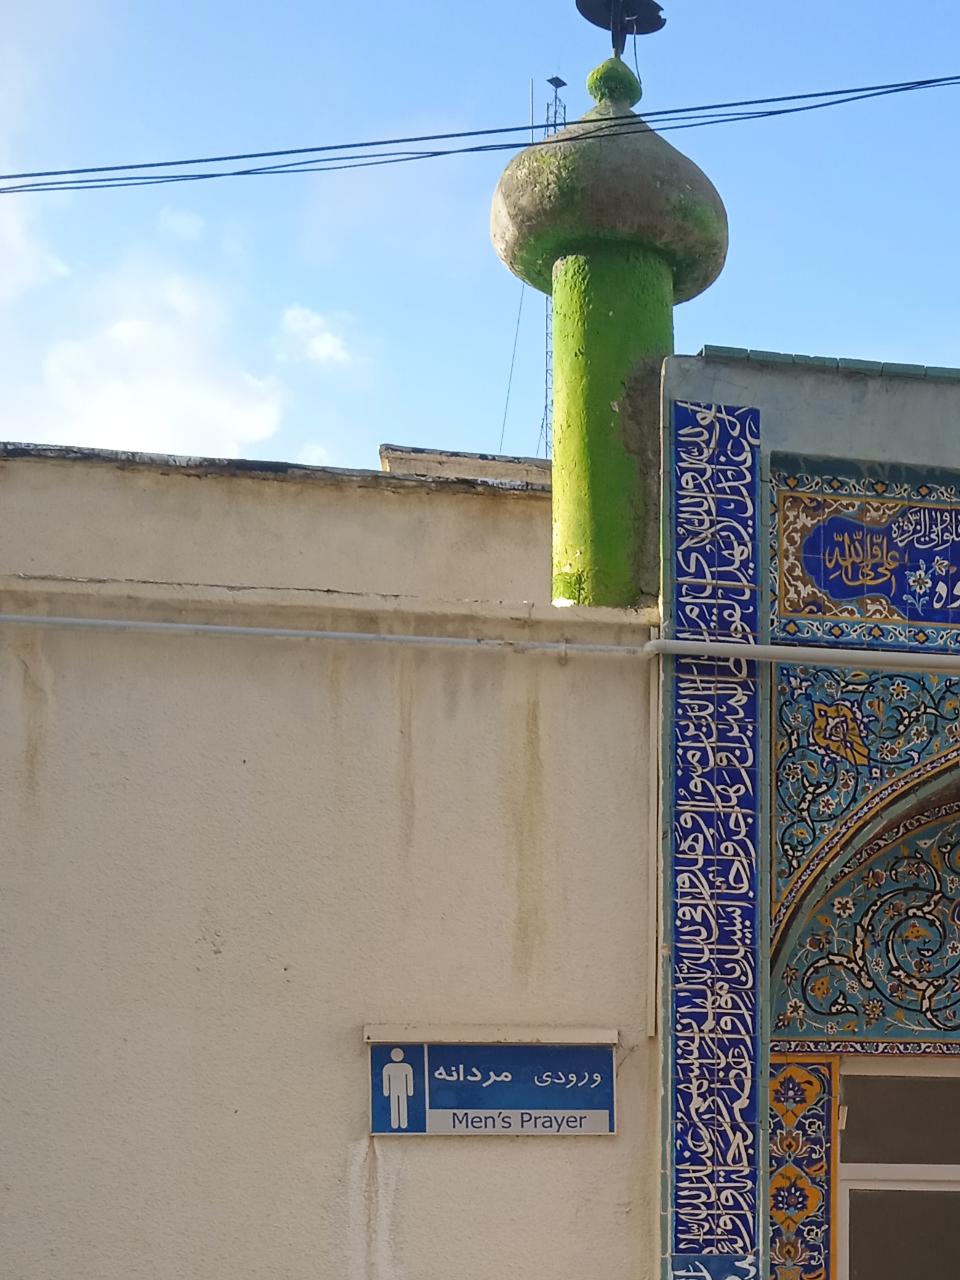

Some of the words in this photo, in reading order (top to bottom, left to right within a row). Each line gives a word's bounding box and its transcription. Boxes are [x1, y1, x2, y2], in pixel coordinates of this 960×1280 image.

[434, 1064, 512, 1087] مردانه
[534, 1070, 602, 1088] ورودی
[452, 1111, 511, 1129] Men's
[520, 1112, 587, 1132] Prayer
